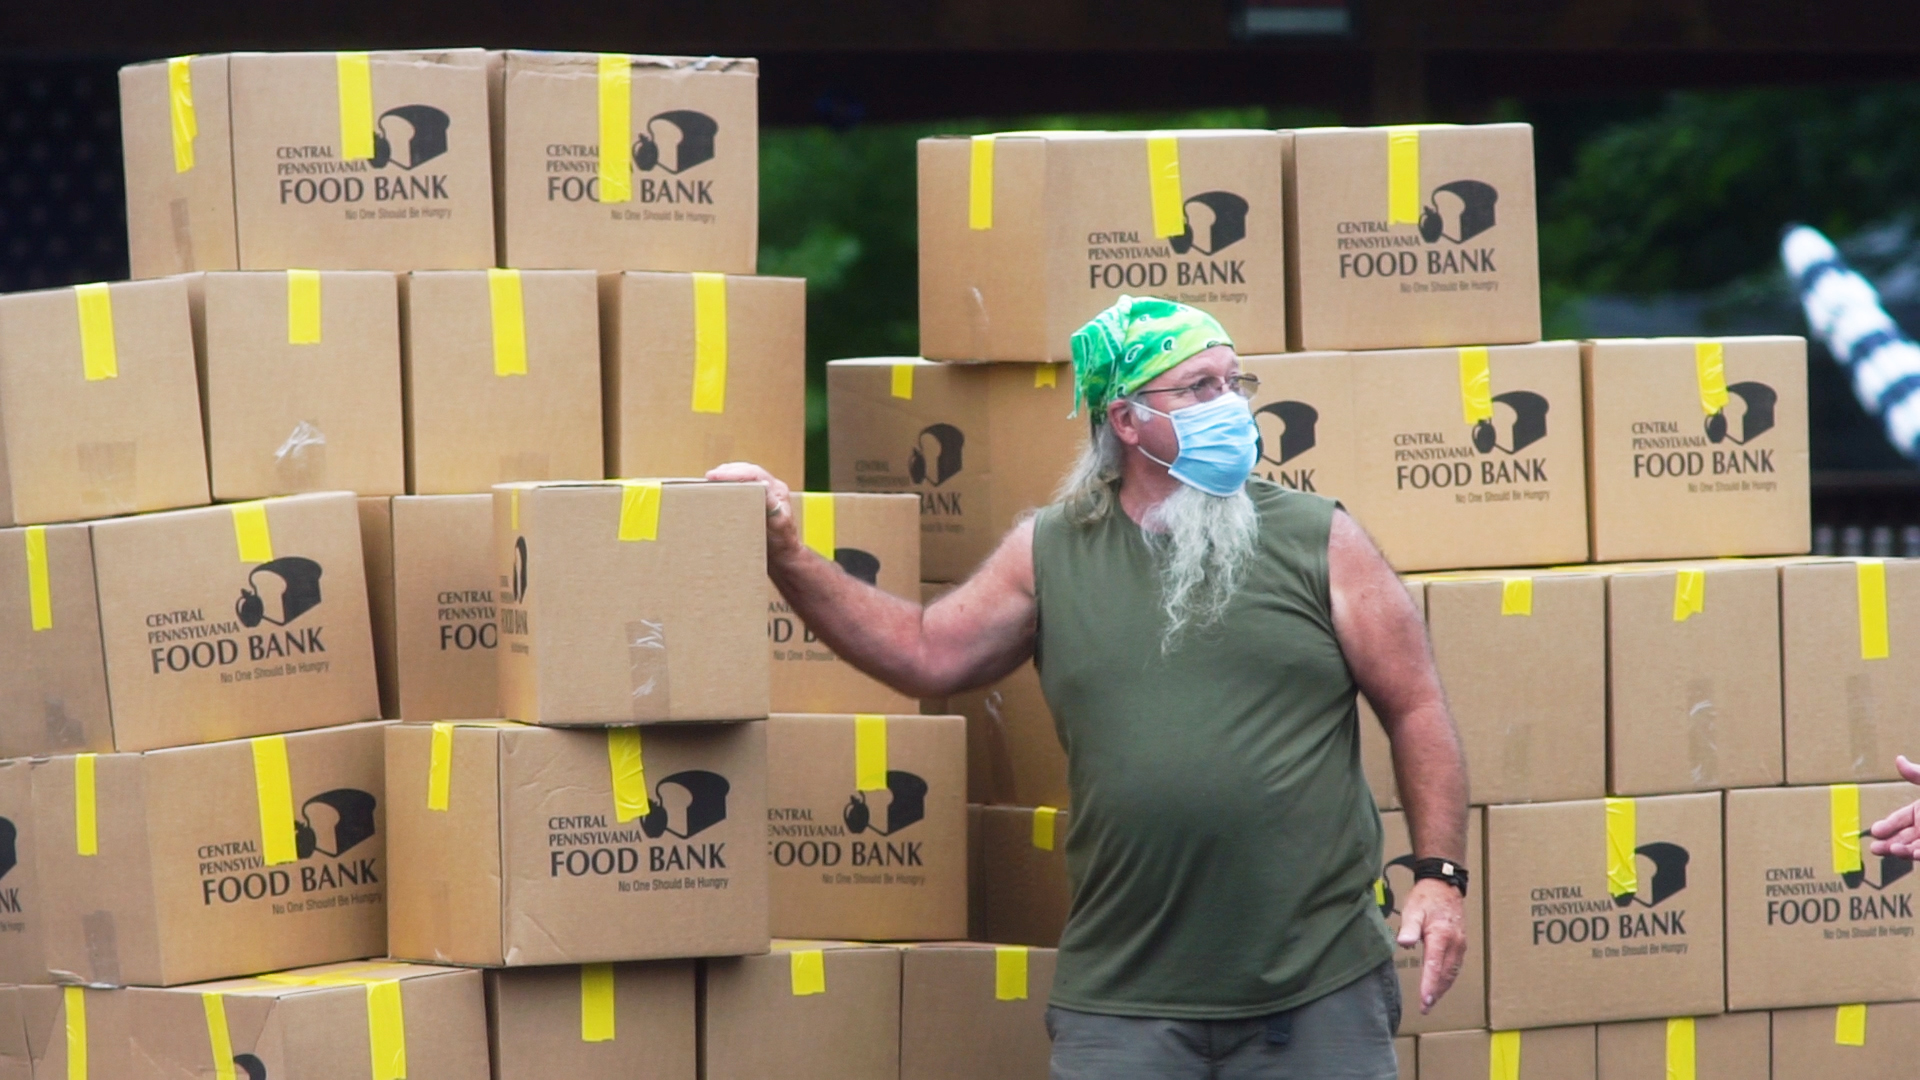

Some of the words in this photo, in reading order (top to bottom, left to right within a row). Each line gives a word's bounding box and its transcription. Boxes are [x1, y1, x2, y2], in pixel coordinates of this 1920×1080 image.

[276, 146, 332, 159] CENTRAL
[546, 144, 599, 157] CENTRAL
[278, 161, 367, 175] PENNSYLVANIA
[547, 160, 633, 173] PENNSYL
[280, 177, 364, 204] FOOD
[374, 175, 448, 200] BANK
[548, 176, 599, 202] FOO
[641, 179, 713, 204] BANK
[1337, 221, 1389, 234] CENTRAL
[1088, 232, 1140, 244] CENTRAL
[1338, 236, 1420, 250] PENNSYLVANIA
[1088, 246, 1170, 260] PENNSYLVANIA
[1340, 251, 1417, 278] FOOD
[1427, 248, 1496, 274] BANK
[1090, 262, 1167, 288] FOOD
[1177, 260, 1246, 286] BANK
[1632, 422, 1678, 434] CENTRAL
[1394, 432, 1444, 446] CENTRAL
[1632, 436, 1707, 450] PENNSYLVANIA
[1394, 446, 1474, 460] PENNSYLVANIA
[1634, 452, 1704, 478] FOOD
[1712, 449, 1775, 474] BANK
[1250, 468, 1316, 492] NK
[1396, 462, 1472, 490] FOOD
[1480, 458, 1548, 484] BANK
[438, 590, 494, 604] CENTRAL
[146, 608, 204, 628] CENTRAL
[438, 606, 497, 620] PENNSYLV
[148, 621, 240, 644] PENNSYLVANIA
[440, 622, 498, 650] FOO
[151, 638, 238, 674] FOOD
[248, 626, 326, 662] BANK
[220, 672, 233, 683] No
[235, 670, 252, 682] One
[254, 666, 284, 680] Should
[286, 664, 296, 675] Be
[298, 661, 330, 674] Hungry
[768, 808, 812, 820] ENTRAL
[548, 816, 608, 830] CENTRAL
[550, 830, 642, 847] PENNSYLVANIA
[768, 825, 844, 838] NNSYLVANIA
[198, 840, 258, 859] CENTRAL
[768, 840, 840, 866] OOD
[852, 842, 922, 866] BANK
[200, 856, 265, 876] PENNSYLV
[551, 848, 638, 877] FOOD
[650, 842, 726, 872] BANK
[203, 870, 290, 906] FOOD
[300, 858, 378, 892] BANK
[1766, 867, 1815, 881] CENTRAL
[618, 880, 630, 892] No
[633, 880, 650, 890] One
[652, 878, 682, 890] Should
[684, 878, 695, 888] Be
[698, 877, 728, 890] Hungry
[1766, 881, 1844, 896] PENNSYLVANIA
[0, 888, 22, 913] NK
[1532, 886, 1582, 900] CENTRAL
[272, 904, 285, 914] No
[287, 902, 304, 913] One
[306, 898, 336, 911] Should
[338, 896, 349, 906] Be
[351, 892, 382, 904] Hungry
[1532, 900, 1612, 916] PENNSYLVANIA
[1768, 898, 1840, 926] FOOD
[1850, 892, 1913, 920] BANK
[1533, 916, 1610, 945] FOOD
[1619, 910, 1686, 939] BANK
